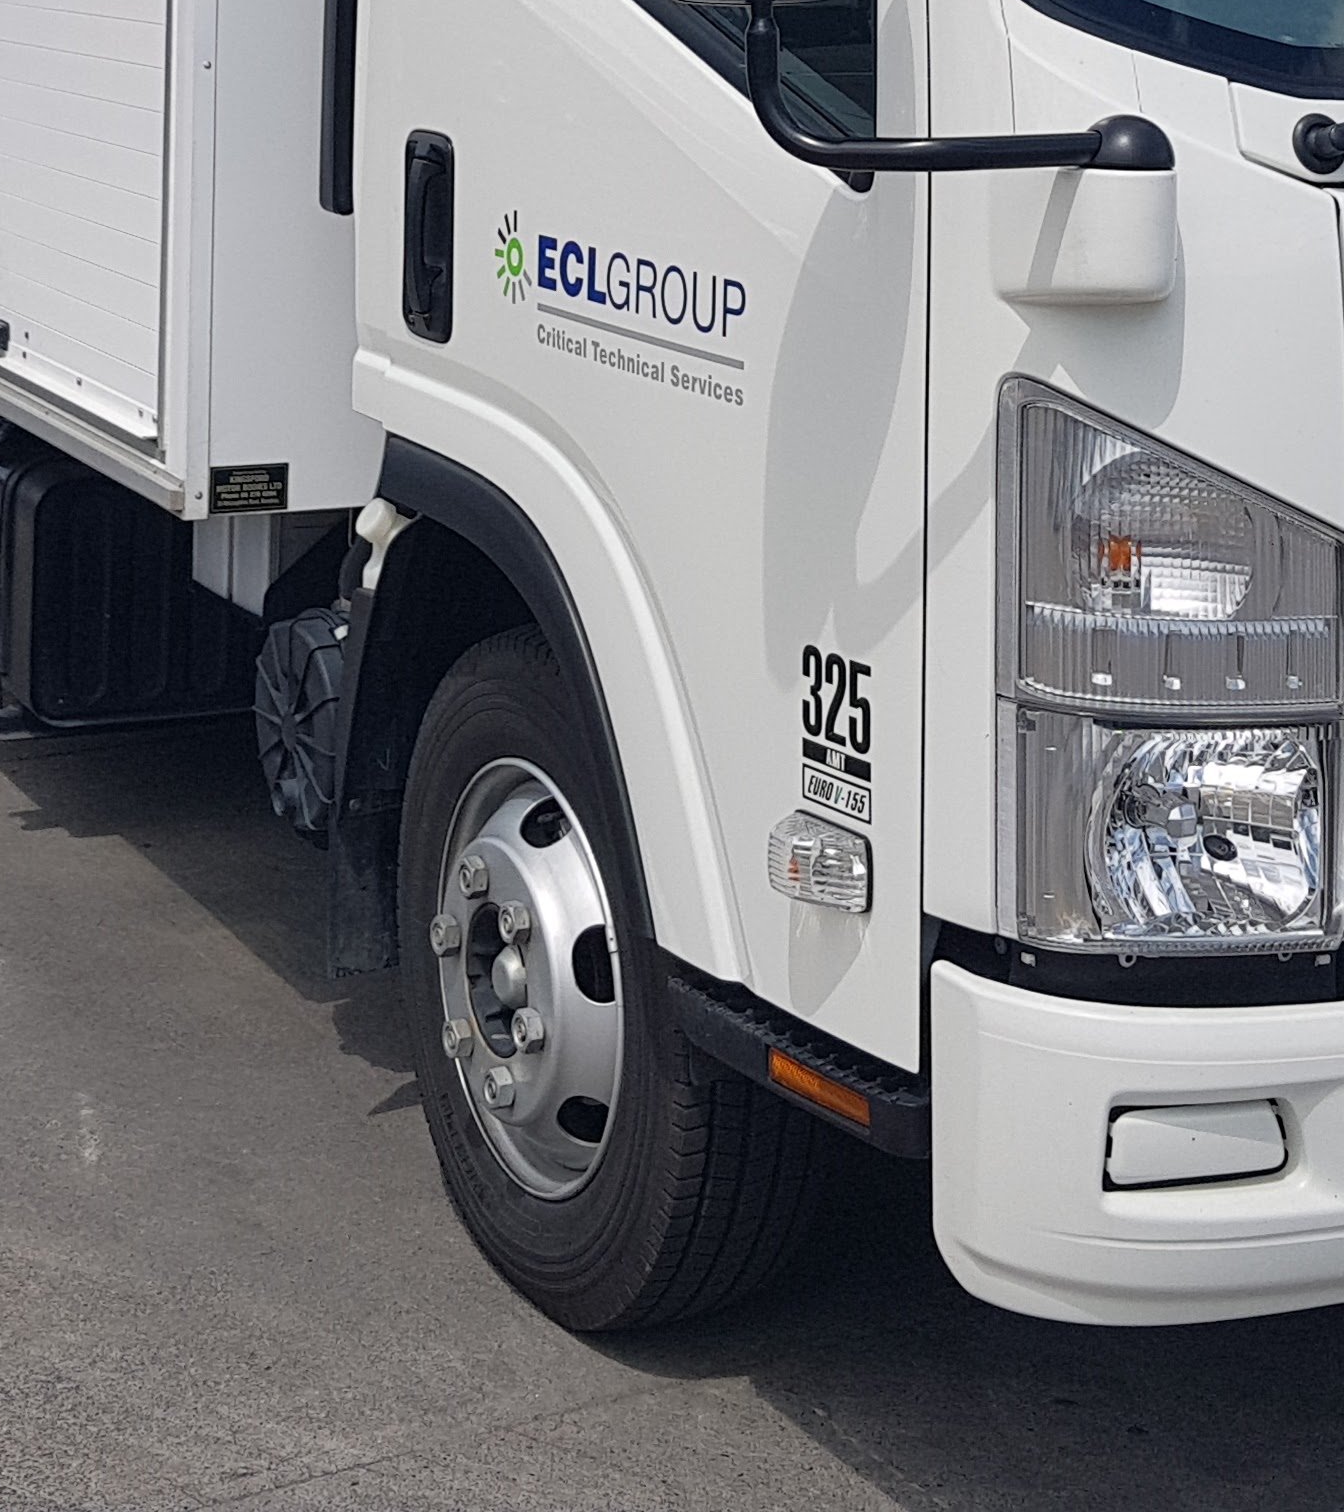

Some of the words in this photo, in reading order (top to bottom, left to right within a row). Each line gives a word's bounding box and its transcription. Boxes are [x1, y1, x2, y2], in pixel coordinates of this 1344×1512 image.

[537, 234, 746, 338] ECLGROUP
[537, 323, 587, 359] Critical
[591, 340, 665, 383] Technical
[670, 365, 745, 407] Services
[803, 644, 871, 754] 325
[807, 774, 833, 802] EURO
[825, 748, 846, 772] AMT
